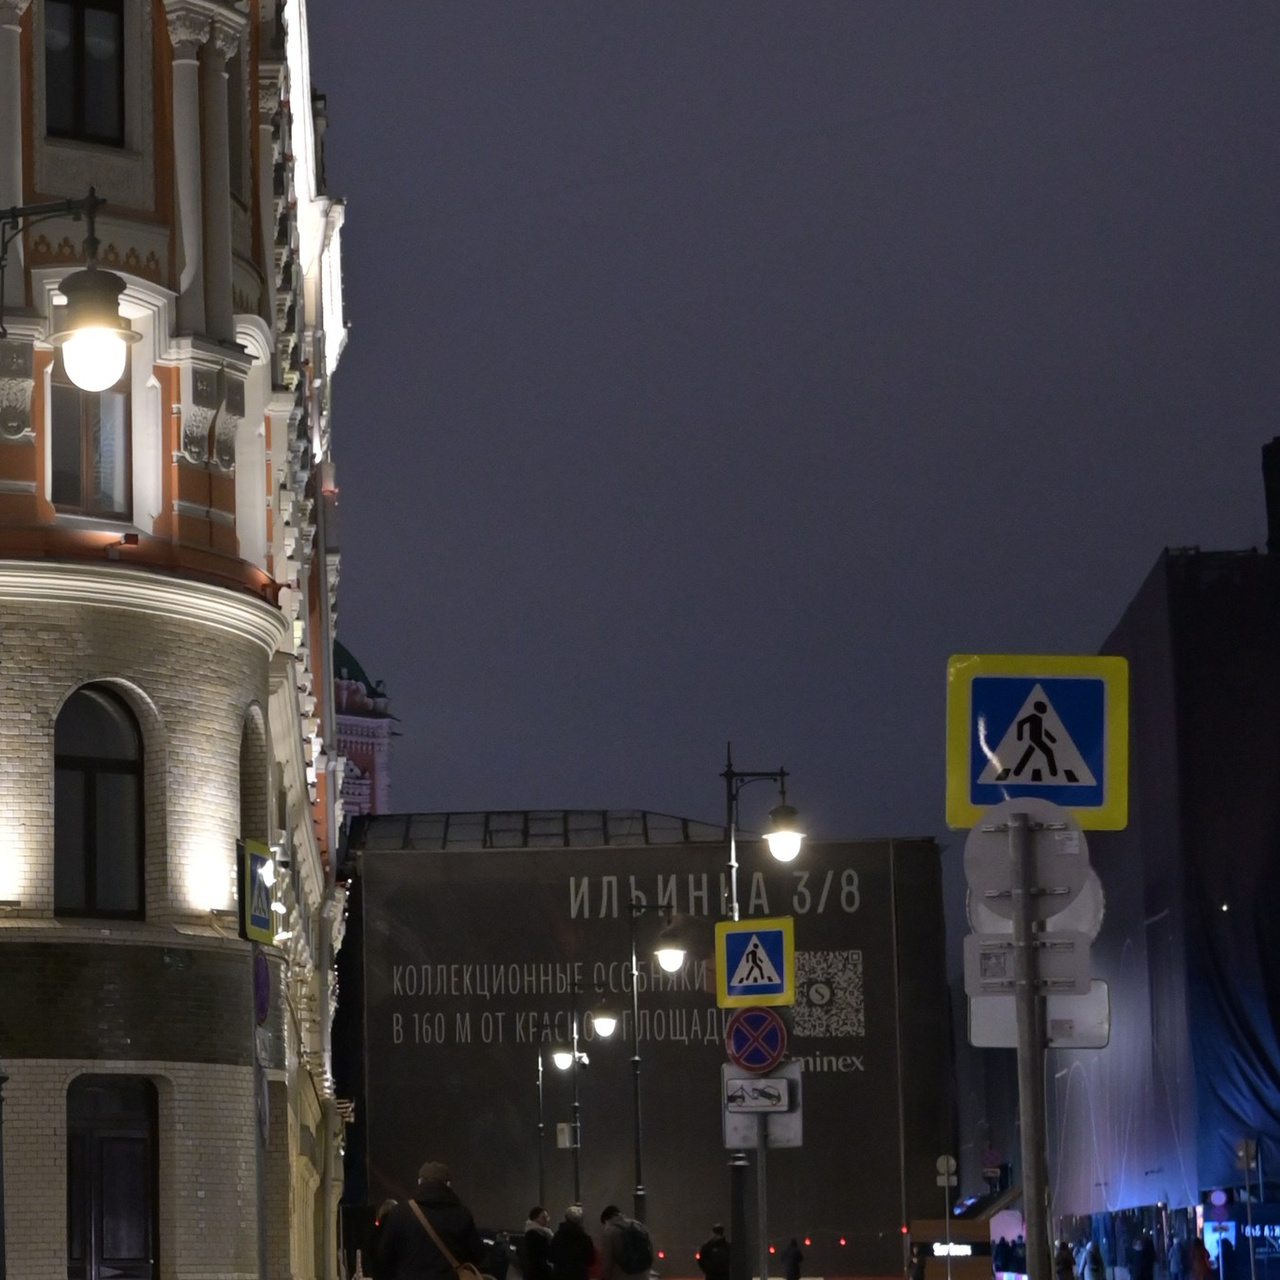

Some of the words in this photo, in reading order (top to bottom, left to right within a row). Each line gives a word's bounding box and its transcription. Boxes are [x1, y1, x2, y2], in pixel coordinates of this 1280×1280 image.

[793, 869, 860, 914] 3/8
[393, 962, 584, 1000] КОЛЛЕКЦИОННЫЕ
[393, 1013, 403, 1044] В
[412, 1012, 445, 1044] 160
[456, 1012, 471, 1043] М
[481, 1012, 505, 1043] ОТ
[516, 1010, 607, 1043] КРАСНО
[782, 1050, 865, 1073] minex
